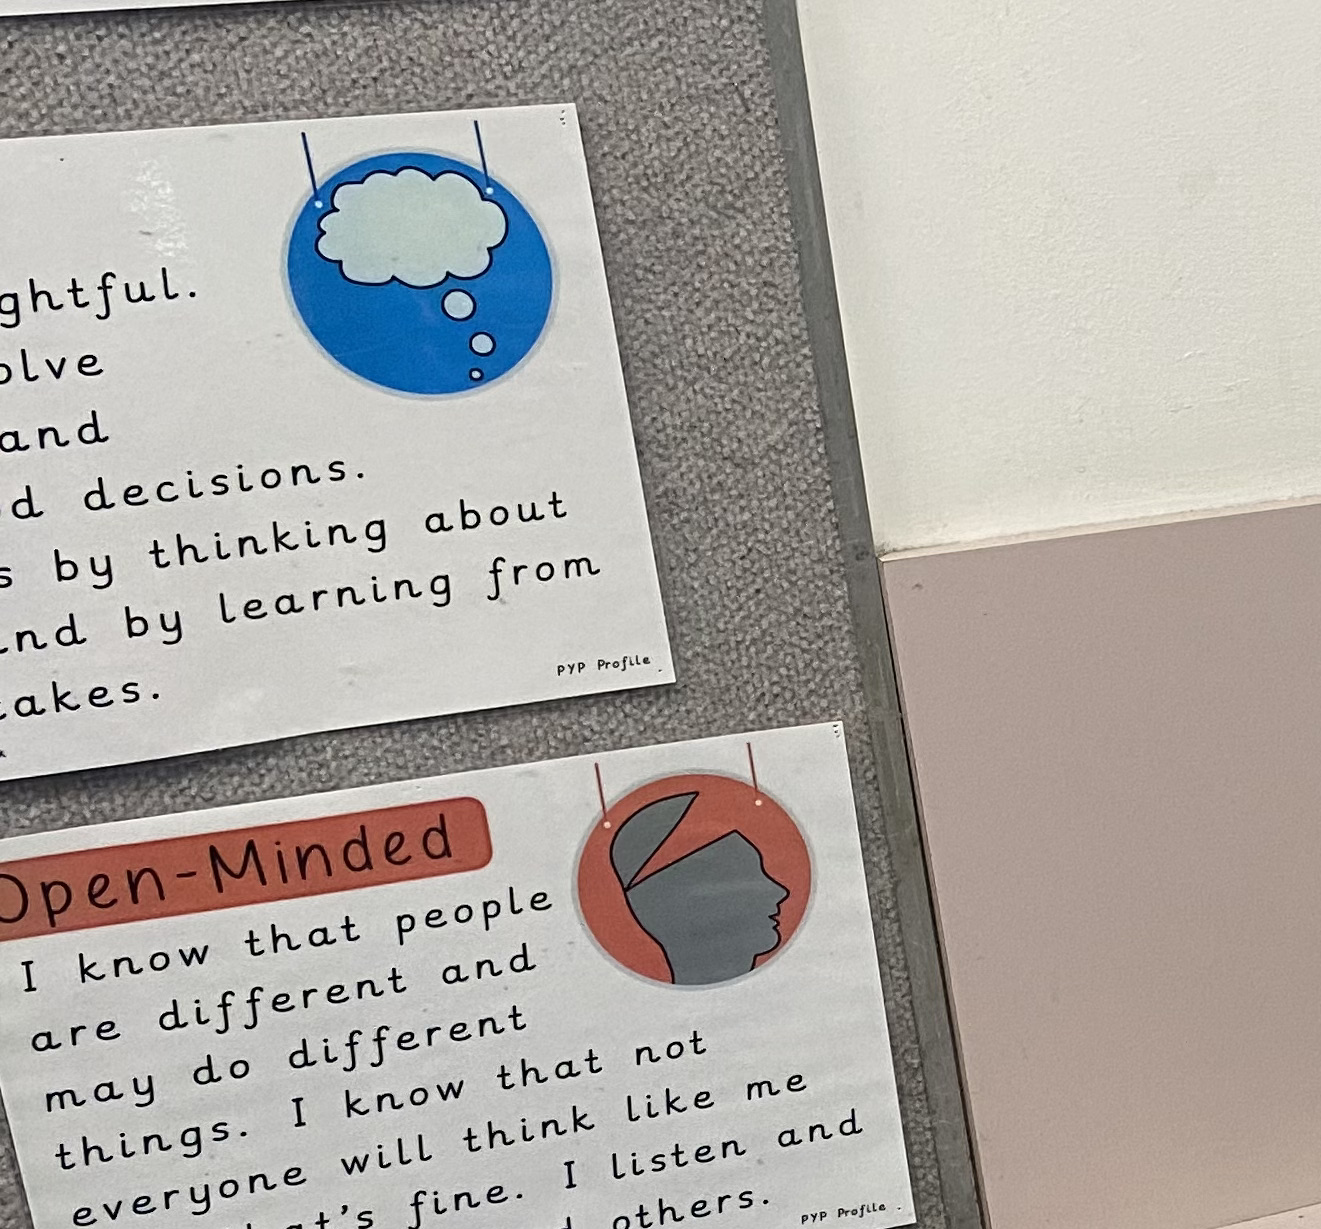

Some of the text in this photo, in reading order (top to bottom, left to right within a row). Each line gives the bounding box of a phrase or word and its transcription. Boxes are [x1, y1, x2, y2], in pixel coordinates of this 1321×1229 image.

[53, 490, 568, 590] by thinking about
[124, 556, 601, 646] by learning from
[556, 654, 651, 677] PYP Profile
[20, 885, 553, 993] I know that people
[563, 1160, 578, 1190] I
[611, 1139, 747, 1180] listen
[777, 1107, 864, 1148] and
[801, 1202, 886, 1225] PYP Profile
